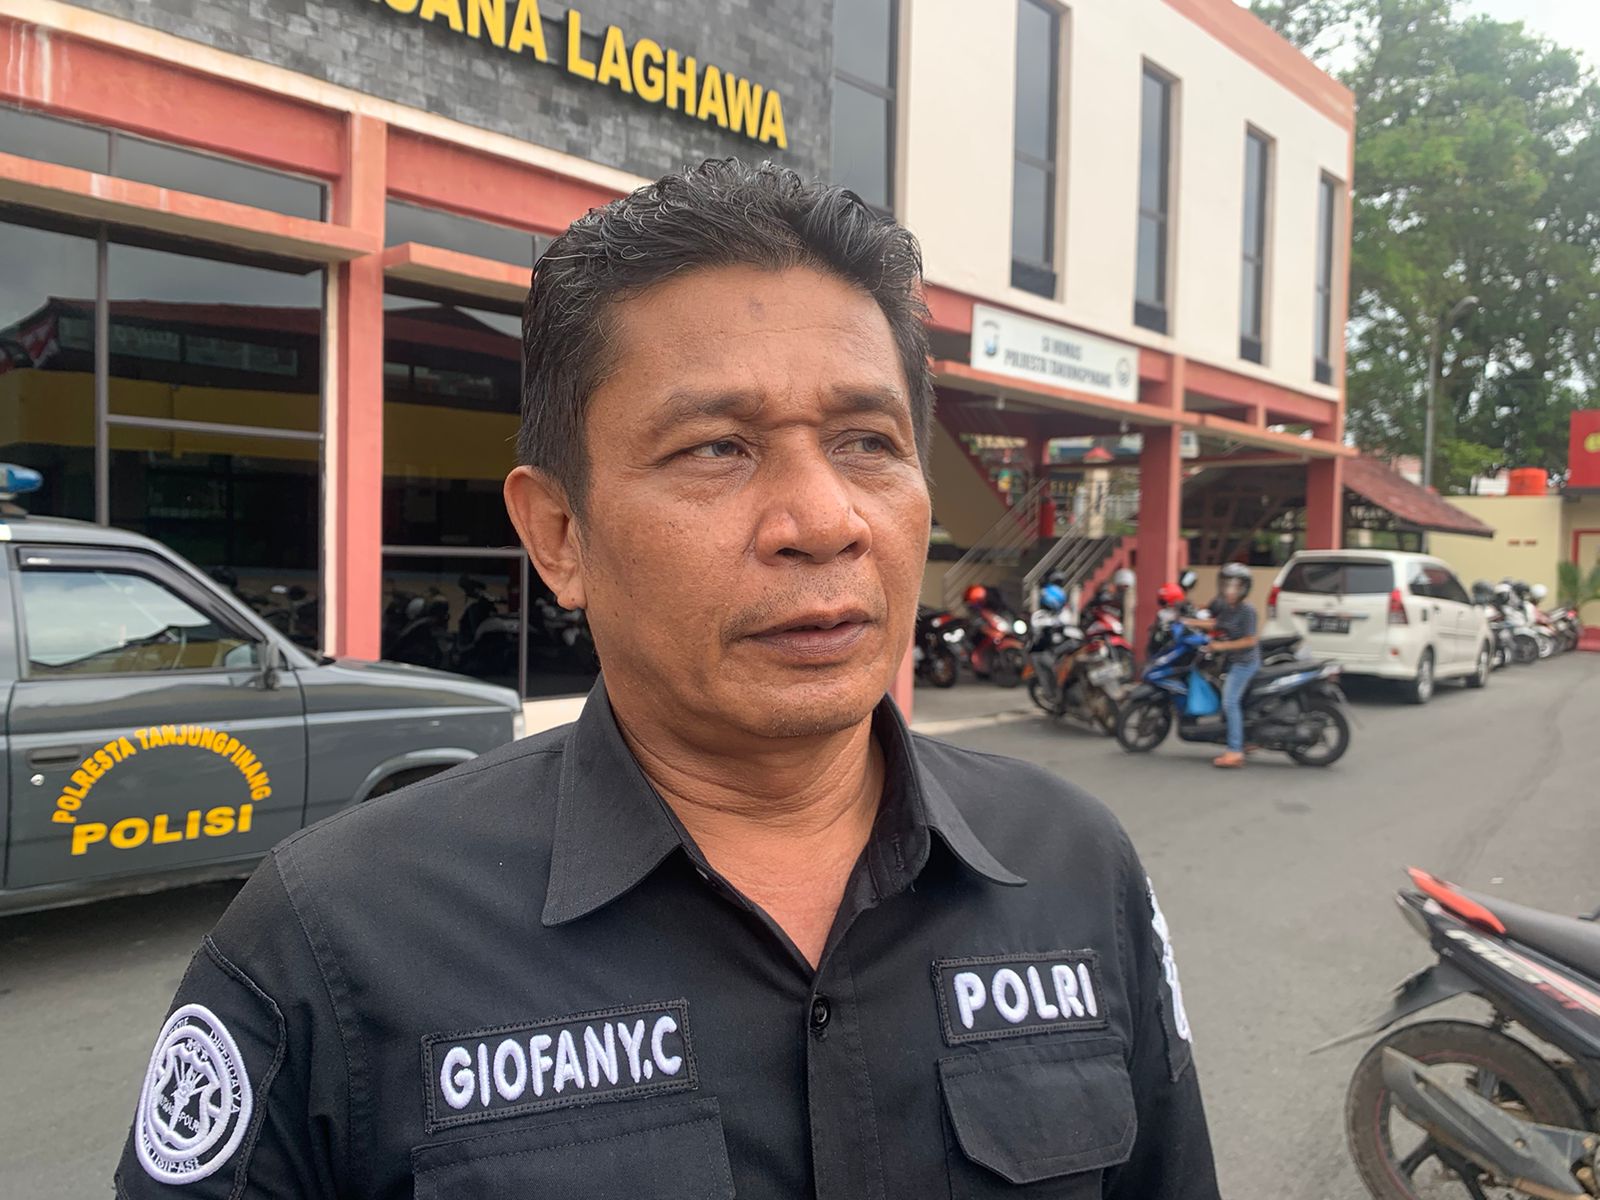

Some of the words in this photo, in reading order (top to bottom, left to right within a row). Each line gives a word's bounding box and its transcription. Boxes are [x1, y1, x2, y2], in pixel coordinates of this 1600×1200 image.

[568, 9, 788, 149] LAGHAWA
[52, 736, 137, 823] POLRESTA
[135, 725, 272, 801] TANJUNGPINANG
[71, 803, 253, 855] POLISI
[954, 963, 1097, 1029] POLRI
[440, 1015, 682, 1109] GIOFANY.C
